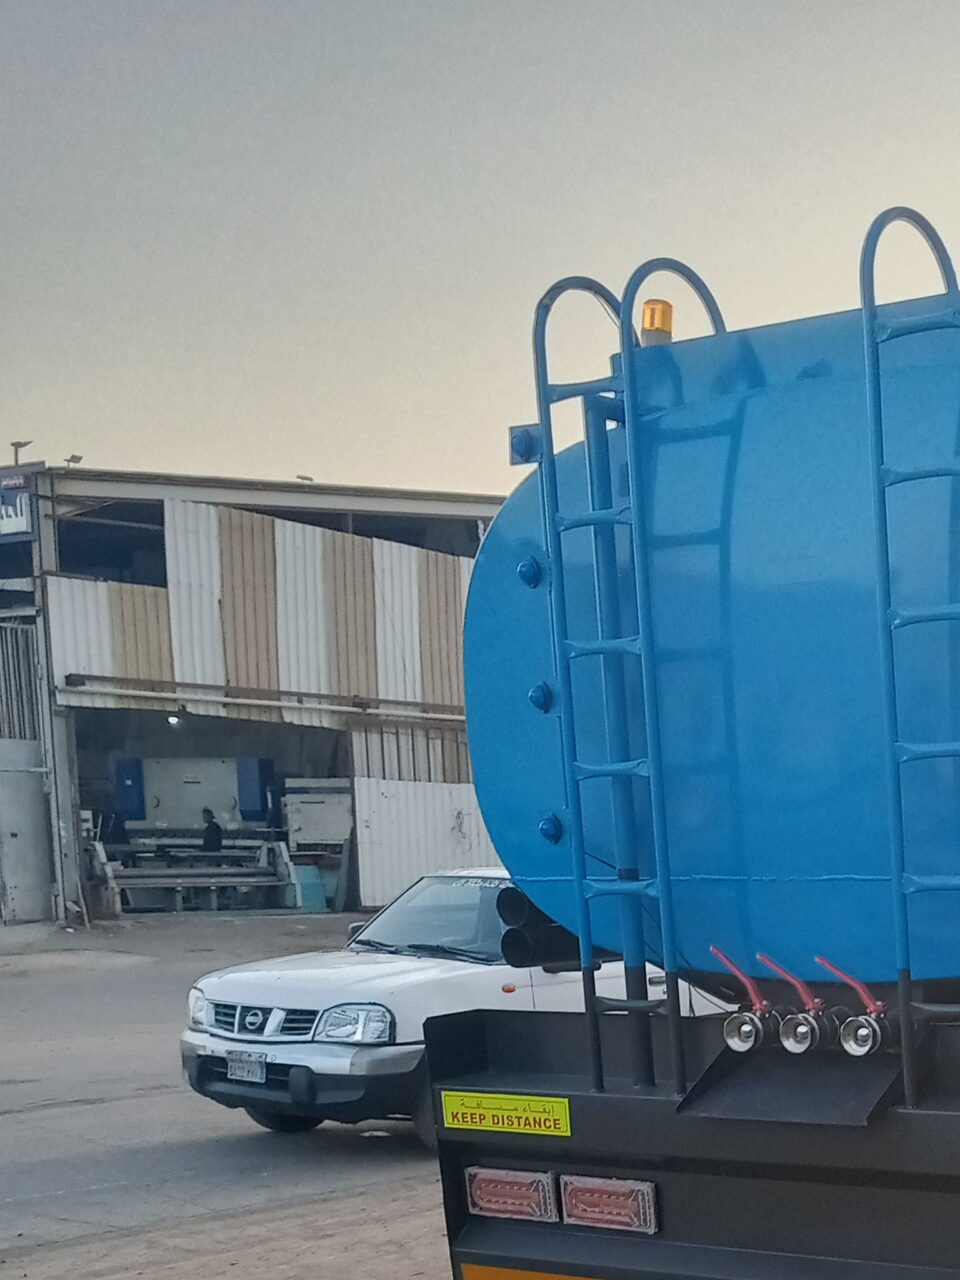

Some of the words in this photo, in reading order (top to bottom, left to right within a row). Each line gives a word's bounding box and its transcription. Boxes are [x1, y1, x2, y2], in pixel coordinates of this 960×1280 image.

[460, 1098, 518, 1112] مسافة
[451, 1111, 486, 1125] KEEP
[491, 1114, 561, 1130] DISTANCE
